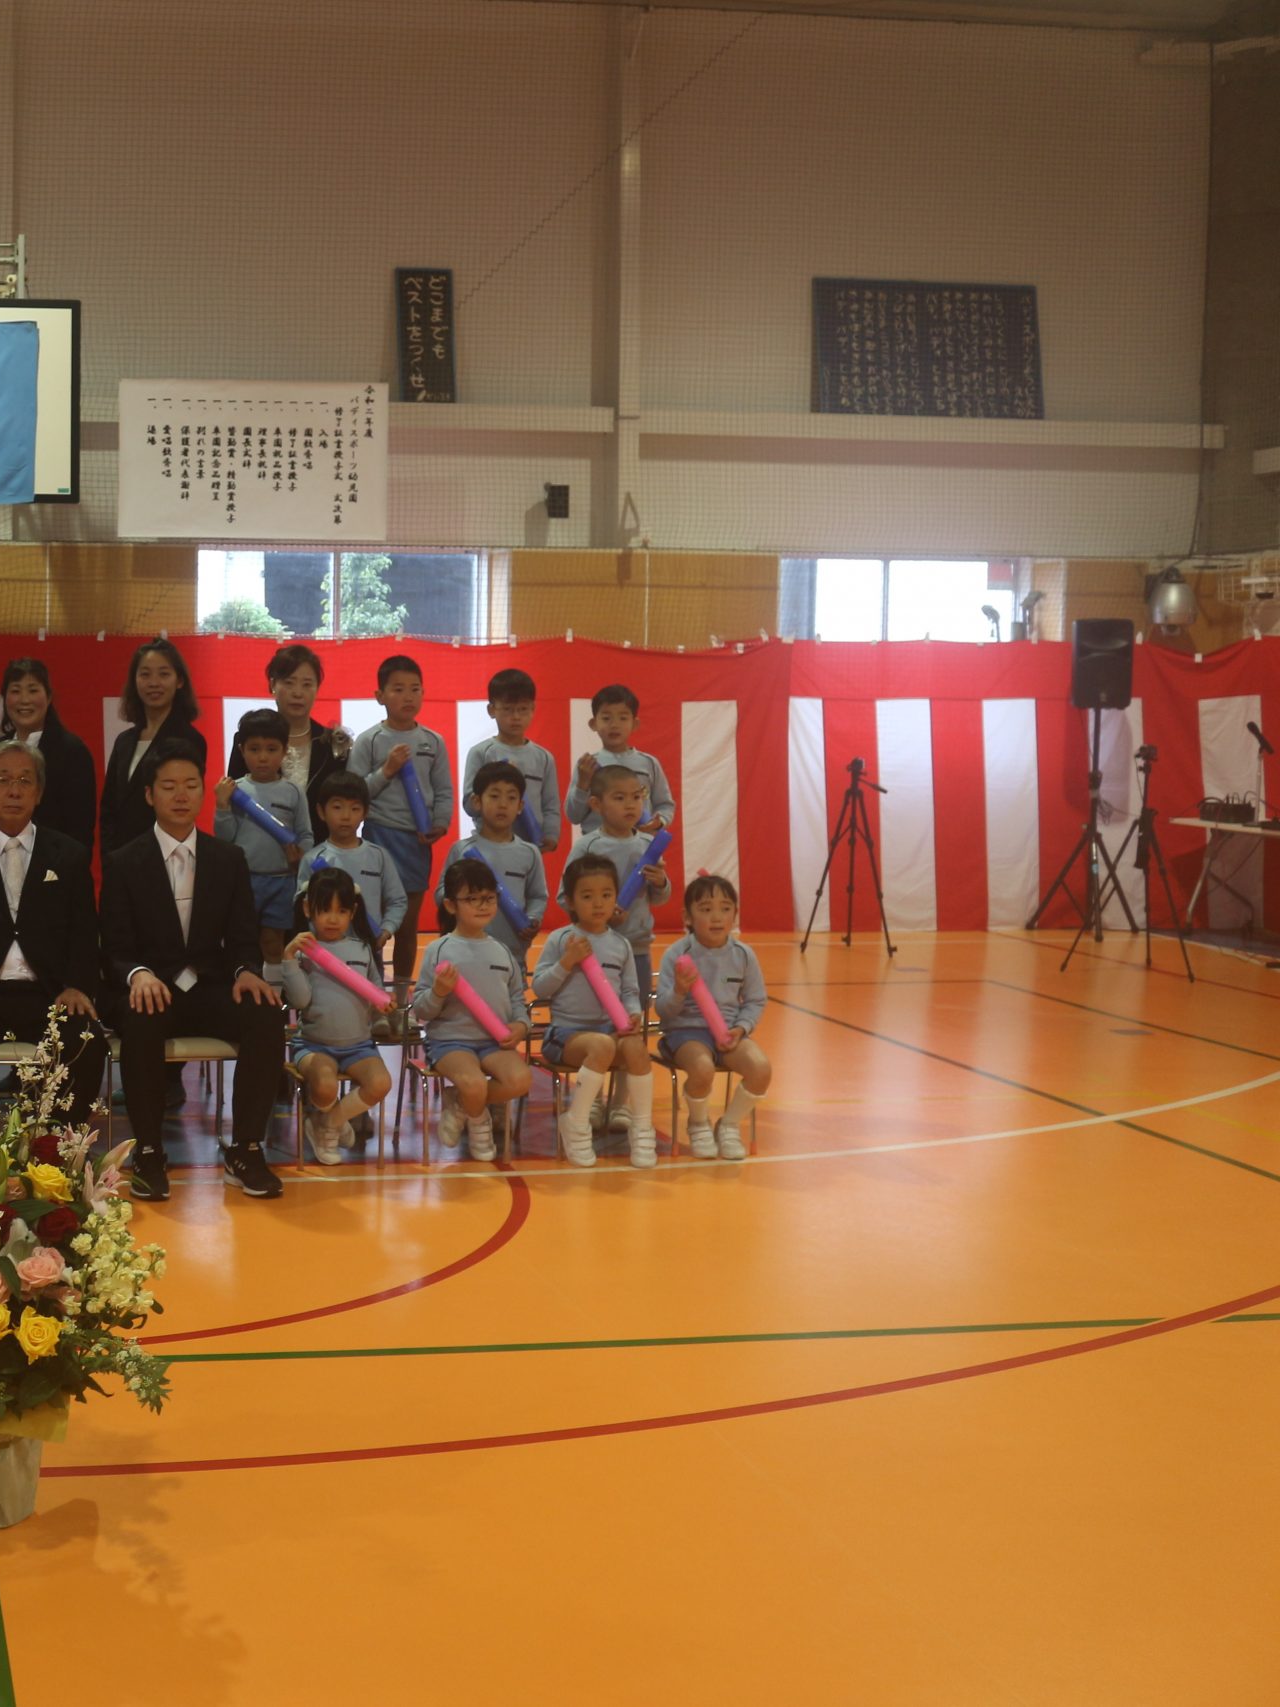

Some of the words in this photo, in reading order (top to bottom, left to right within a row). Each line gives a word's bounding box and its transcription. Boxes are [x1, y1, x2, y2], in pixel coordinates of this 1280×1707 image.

[348, 395, 360, 503] バディスポーツ幼児園
